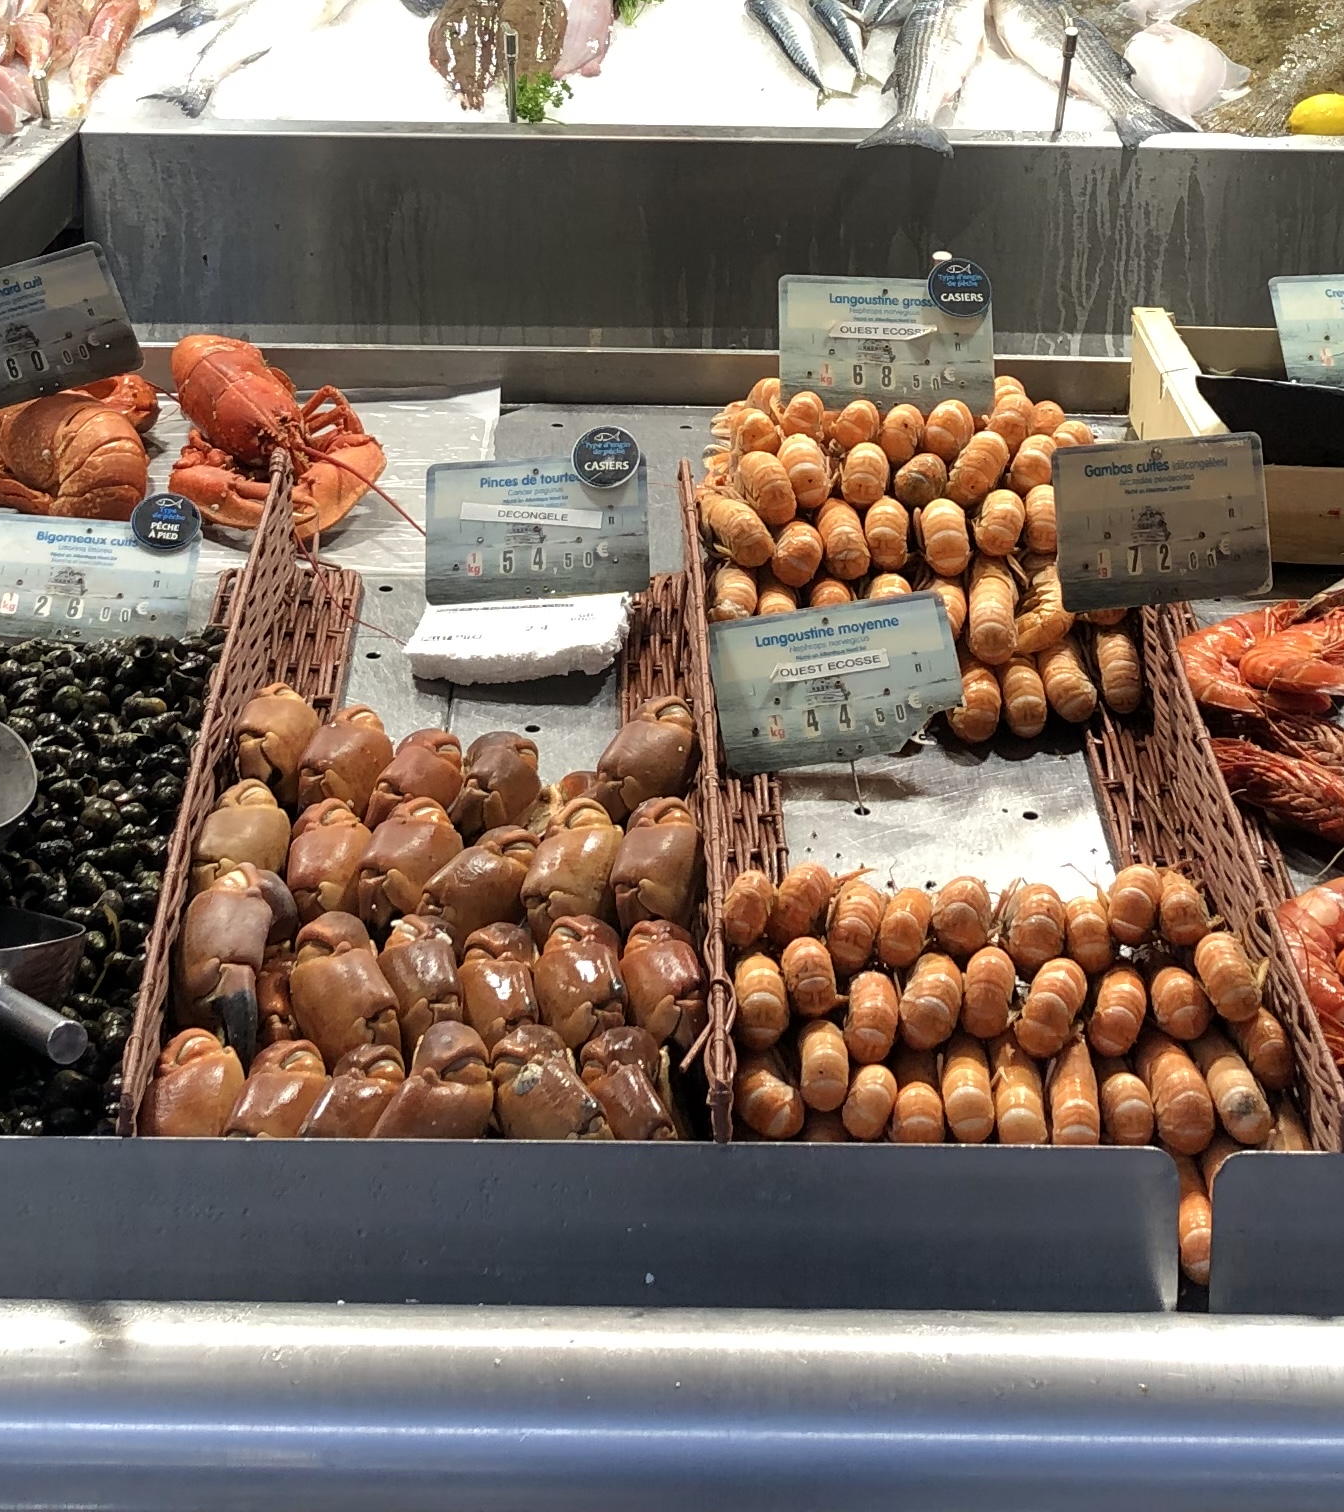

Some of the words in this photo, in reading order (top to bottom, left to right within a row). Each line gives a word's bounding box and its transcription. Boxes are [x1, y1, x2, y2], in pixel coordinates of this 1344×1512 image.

[23, 276, 43, 290] cuit
[829, 293, 899, 308] Langoustine
[940, 292, 984, 303] CASIERS
[840, 326, 879, 335] OUEST
[584, 460, 629, 471] CASIERS
[1084, 461, 1133, 478] Gambas
[1136, 457, 1170, 474] cuites
[480, 475, 518, 489] Pinces
[521, 473, 537, 486] de
[497, 510, 568, 522] DECONGELE
[150, 521, 180, 532] PÊCHE
[36, 531, 106, 546] Bigorneaux
[110, 533, 138, 547] cuits
[148, 530, 156, 539] À
[157, 531, 179, 540] PIED
[755, 627, 835, 649] Langoustine
[838, 617, 900, 639] moyenne
[780, 666, 817, 678] OUEST
[828, 654, 881, 672] ECOSSE
